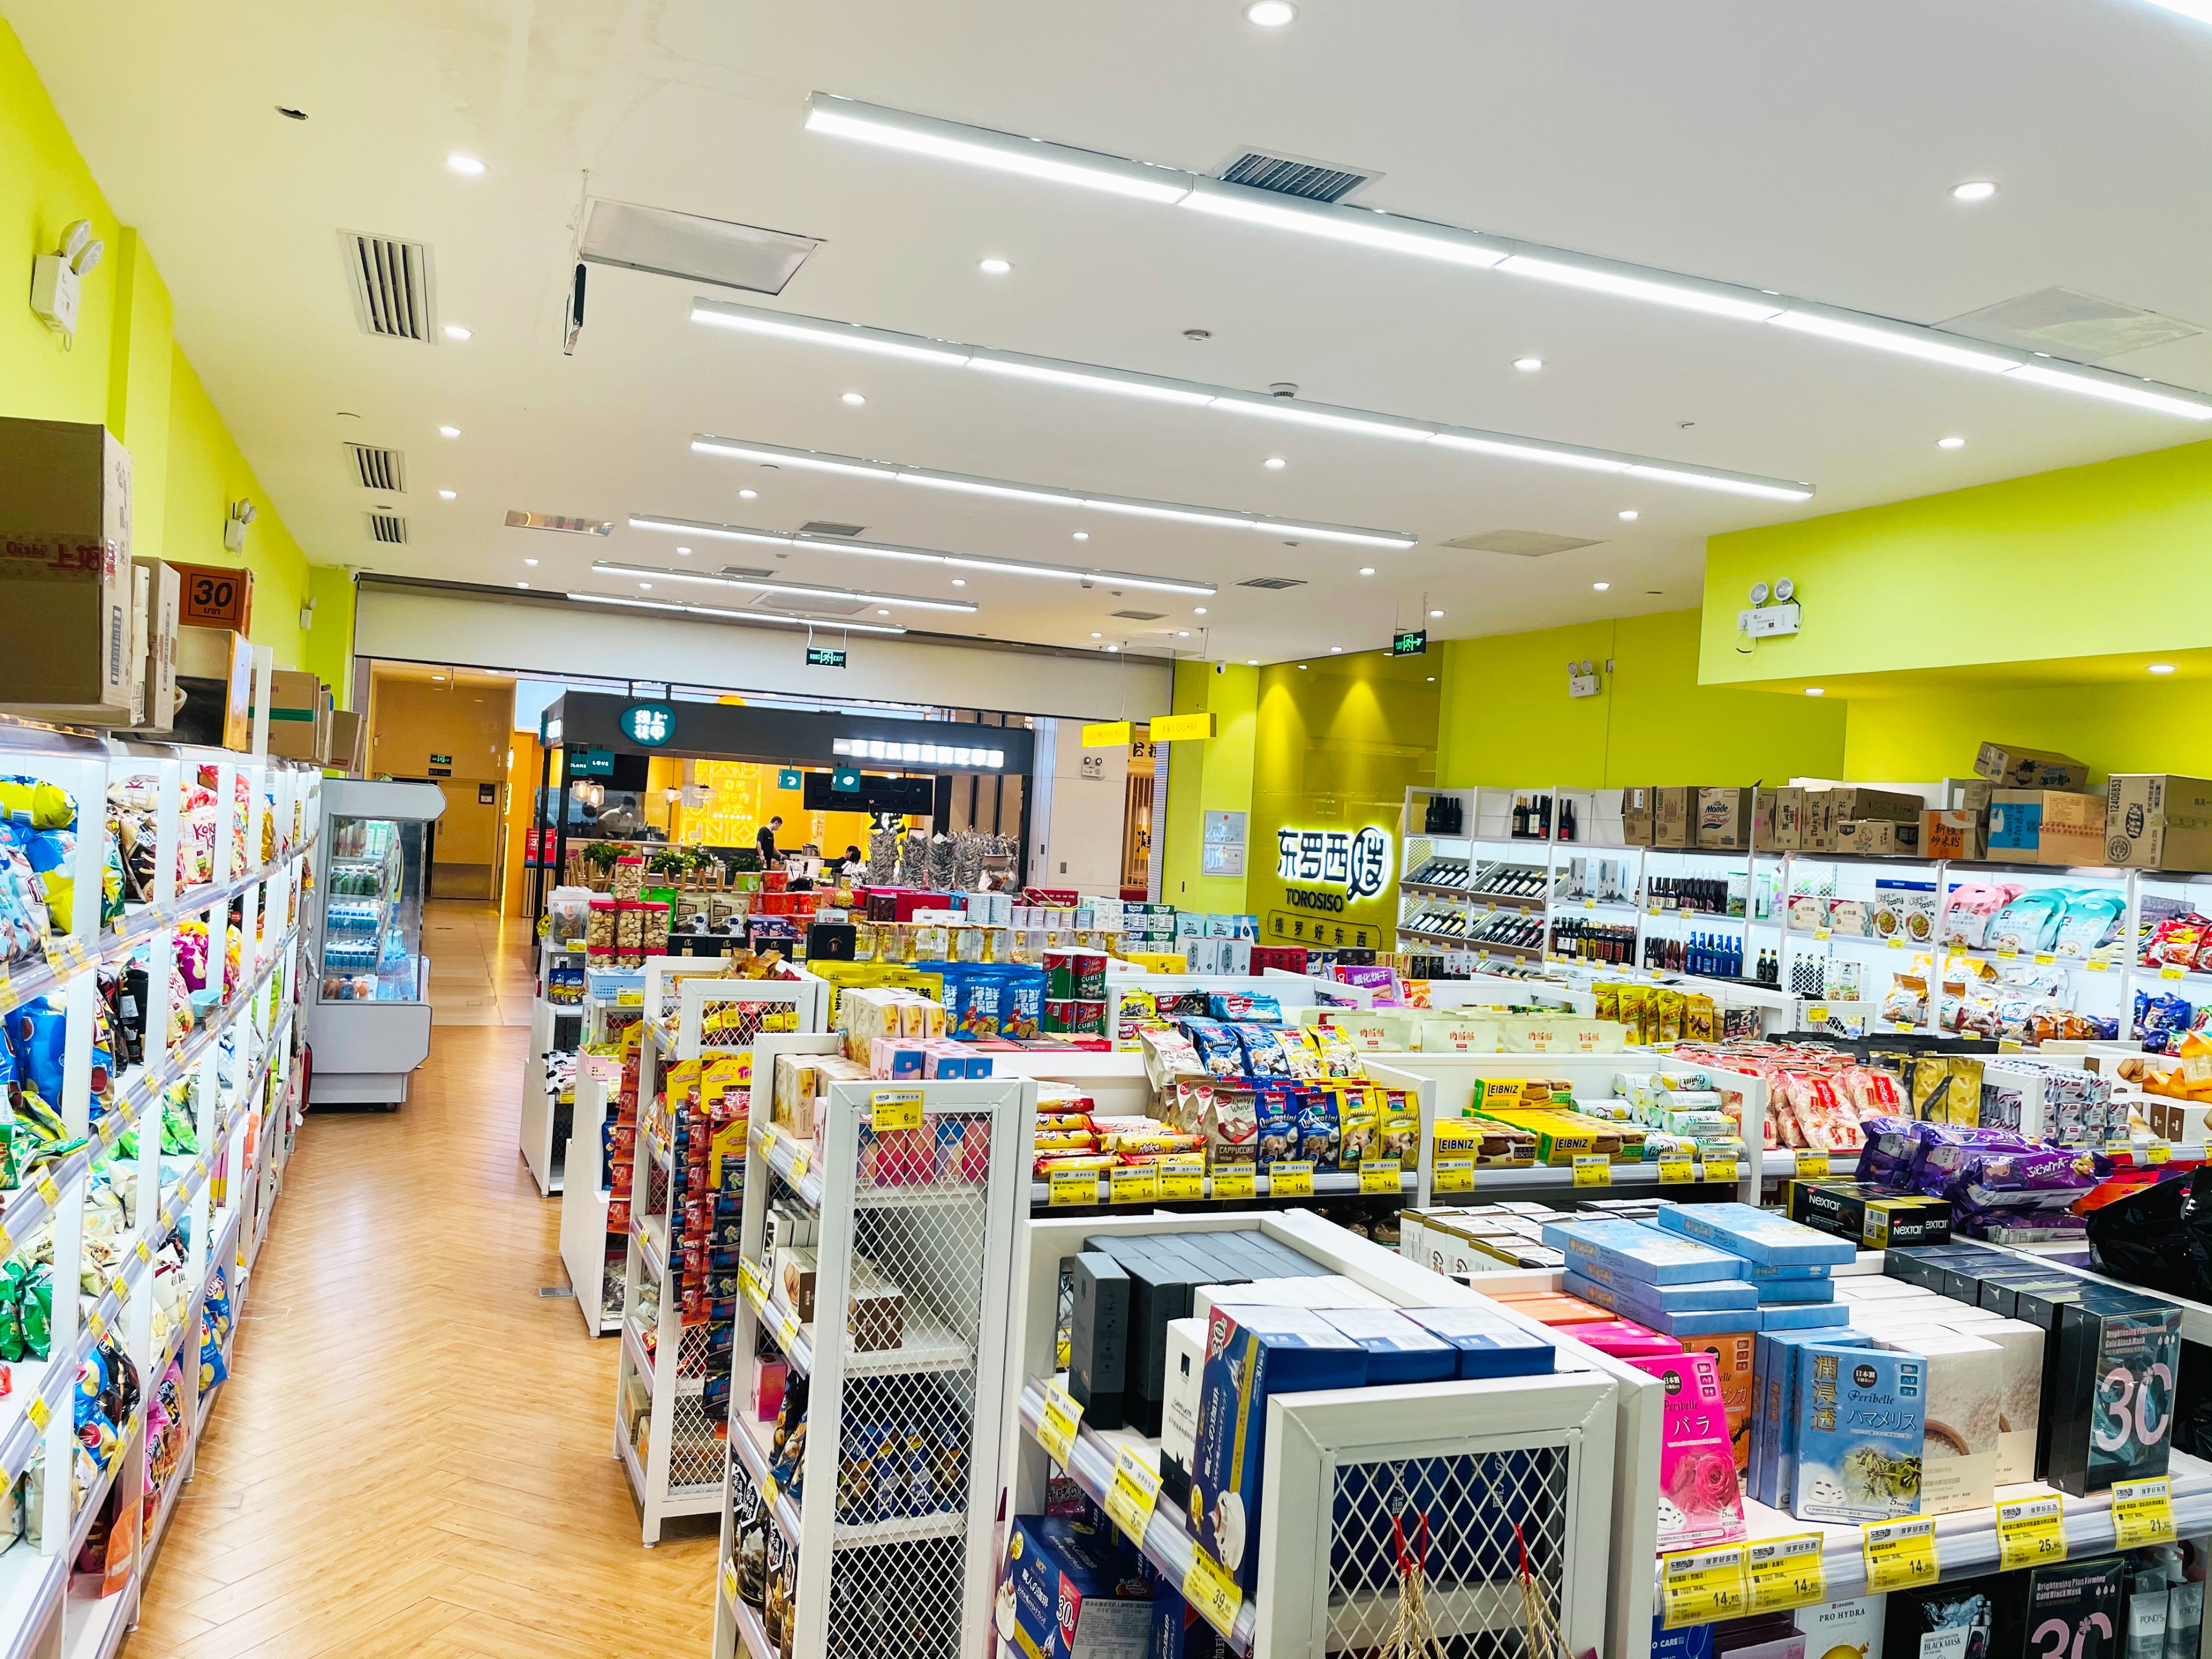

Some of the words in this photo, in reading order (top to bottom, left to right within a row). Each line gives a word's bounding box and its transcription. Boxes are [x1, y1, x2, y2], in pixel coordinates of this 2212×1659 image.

[193, 579, 233, 607] 30
[1177, 721, 1197, 732] CASHIER
[1705, 803, 1728, 814] Monde
[1286, 887, 1344, 913] TOROSISO
[1877, 894, 1891, 903] Light
[1886, 896, 1904, 907] Tasty
[1909, 896, 1923, 905] Light
[1275, 917, 1367, 948] 搜罗好东西
[1081, 973, 1102, 983] CUBES
[1354, 971, 1388, 986] 威化饼干
[970, 986, 1000, 1000] 海鲜
[1014, 988, 1041, 1002] 海鲜
[1488, 1083, 1519, 1097] LEIBNIZ
[1260, 1113, 1297, 1128] Quadratini
[1341, 1109, 1377, 1125] Quadratini
[1382, 1113, 1418, 1127] Quadratini
[1219, 1145, 1254, 1155] CAPPUCCINO
[1439, 1138, 1474, 1153] LEIBNIZ
[1555, 1137, 1588, 1151] LEIBNIZ
[1855, 1370, 1875, 1379] 日本製
[1848, 1390, 1895, 1405] Peribelle
[1664, 1399, 1698, 1412] Peribelle
[1674, 1416, 1710, 1437] バラ
[1846, 1409, 1916, 1431] ハマメリス
[1785, 1542, 1817, 1553] 搜罗好东西
[1705, 1554, 1739, 1566] 搜罗好东西
[1793, 1578, 1819, 1594] 14.80
[2037, 1580, 2071, 1592] Brightening
[2071, 1577, 2084, 1587] Plus
[2084, 1575, 2106, 1586] Firming
[1713, 1591, 1740, 1608] 14.80
[2050, 1589, 2066, 1599] Black
[2066, 1587, 2082, 1597] Mask
[1056, 1594, 1074, 1627] 30
[1819, 1612, 1835, 1622] PRO
[1838, 1608, 1866, 1620] HYDRA
[2140, 1613, 2165, 1624] POND'S
[1660, 1637, 1678, 1648] CARE
[1924, 1640, 1944, 1651] BLACK
[1944, 1637, 1961, 1648] MASK
